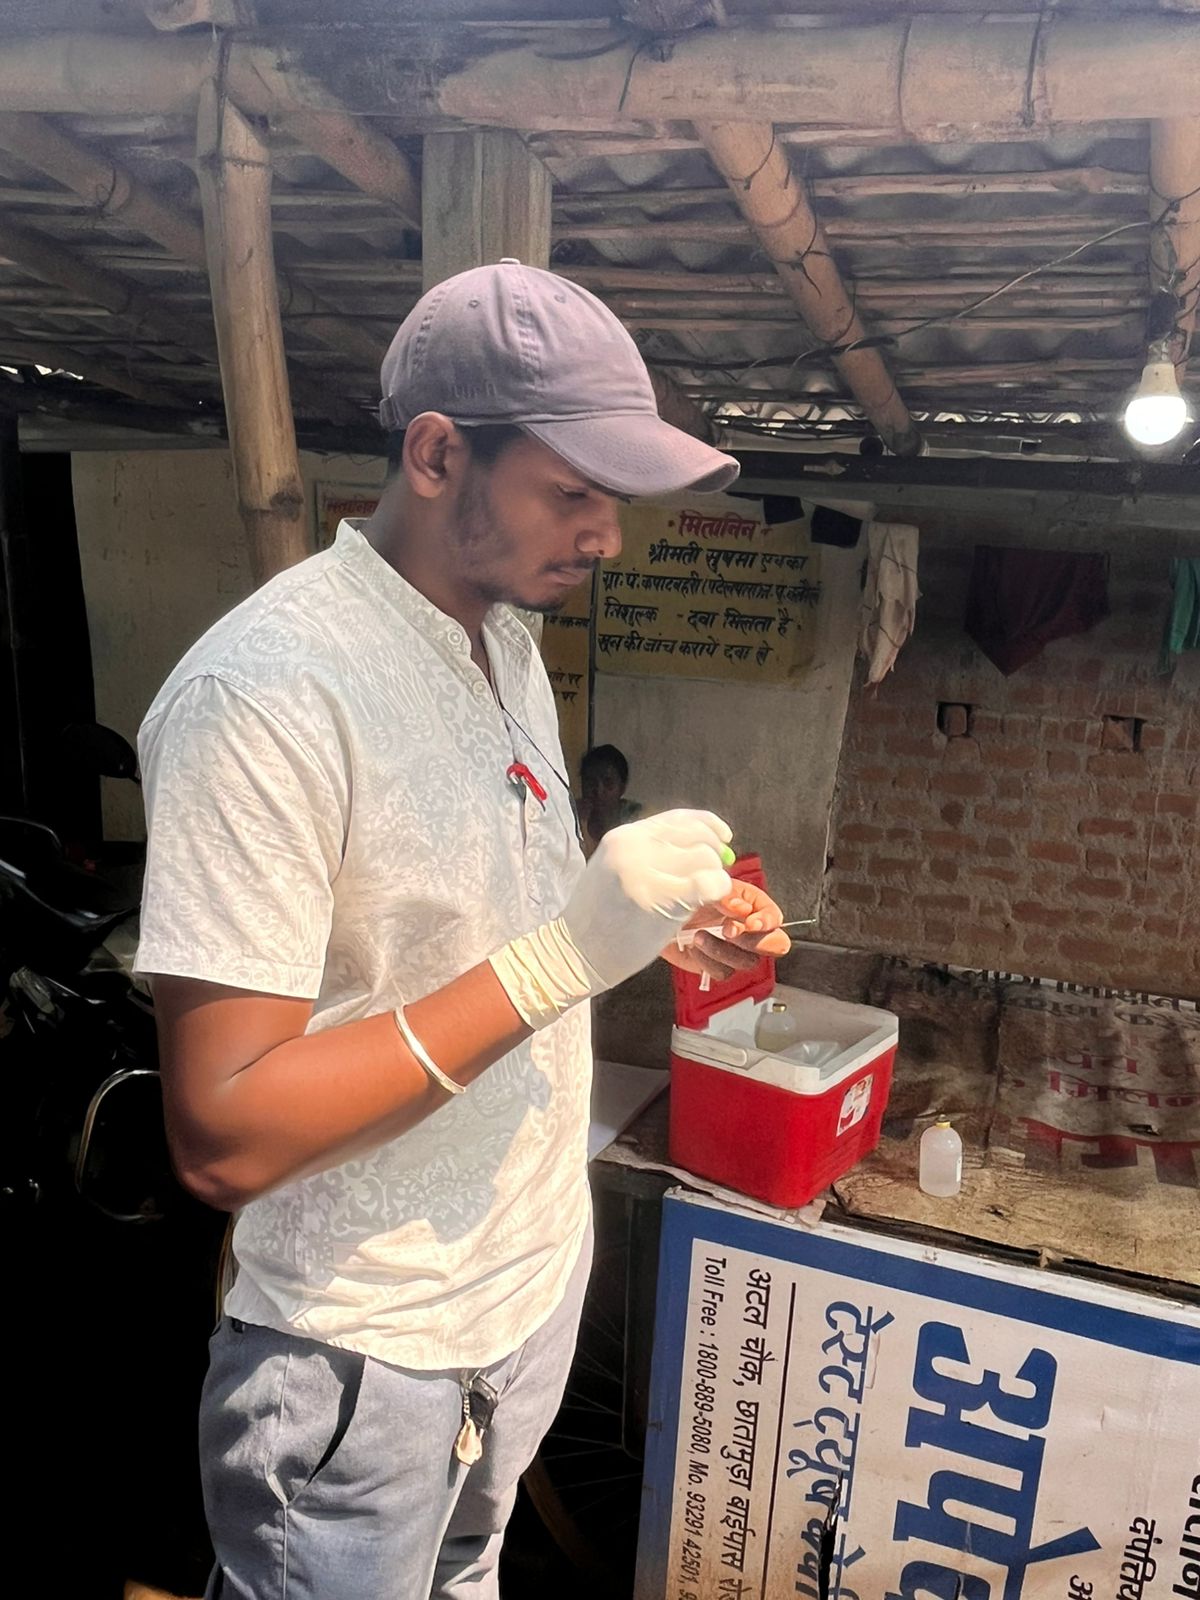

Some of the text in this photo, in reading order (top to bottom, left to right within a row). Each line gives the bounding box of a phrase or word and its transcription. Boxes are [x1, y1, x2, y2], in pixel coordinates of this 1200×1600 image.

[678, 509, 761, 539] मितानिन
[648, 539, 703, 566] श्रीमती
[687, 608, 720, 632] दवा
[722, 607, 776, 636] मिलता
[623, 630, 643, 653] की
[723, 643, 755, 664] दवा
[703, 1257, 727, 1286] Toll
[699, 1289, 724, 1326] Free
[742, 1268, 774, 1330] अटल
[817, 1300, 895, 1405] टेस्ट
[688, 1342, 721, 1456] 1800-889-5080,
[720, 1399, 760, 1491] छातामुड़ा
[687, 1459, 710, 1487] Mo.
[683, 1491, 707, 1537] 93291
[719, 1495, 757, 1574] बाईपास
